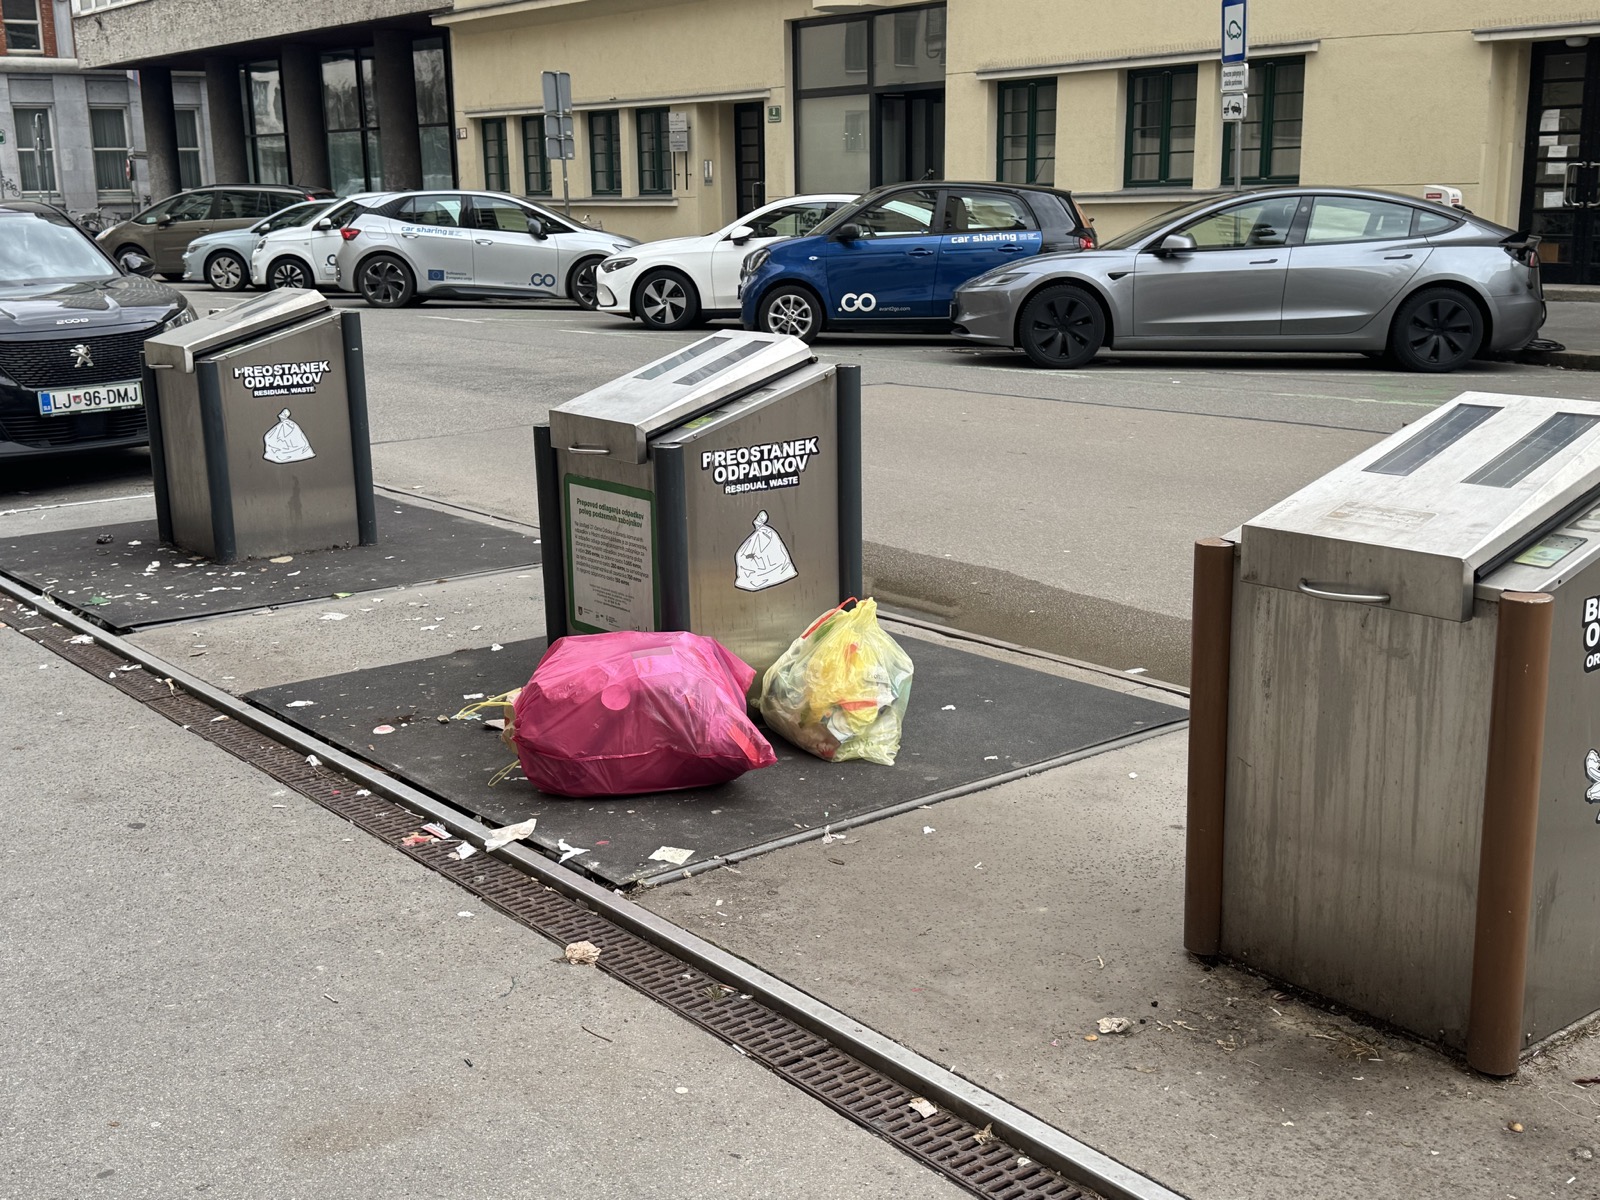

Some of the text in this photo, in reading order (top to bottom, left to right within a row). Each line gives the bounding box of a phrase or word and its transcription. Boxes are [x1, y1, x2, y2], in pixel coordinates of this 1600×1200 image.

[416, 226, 447, 236] sharing
[951, 236, 970, 244] car
[972, 232, 1017, 242] sharing
[56, 317, 89, 325] 2008
[234, 360, 330, 378] PREOSTANEK
[244, 372, 322, 388] ODPADKOV
[52, 387, 138, 410] LJ 96-DMJ
[254, 389, 289, 397] RESIDUAL
[702, 437, 818, 468] PREOSTANEK
[714, 454, 809, 483] ODPADKOV
[725, 476, 799, 494] RESIDUAL WASTE
[576, 498, 597, 509] Prepoved
[621, 508, 644, 519] odpadkov
[578, 508, 591, 516] poleg
[618, 517, 642, 528] zabojnikov
[1584, 597, 1600, 623] B
